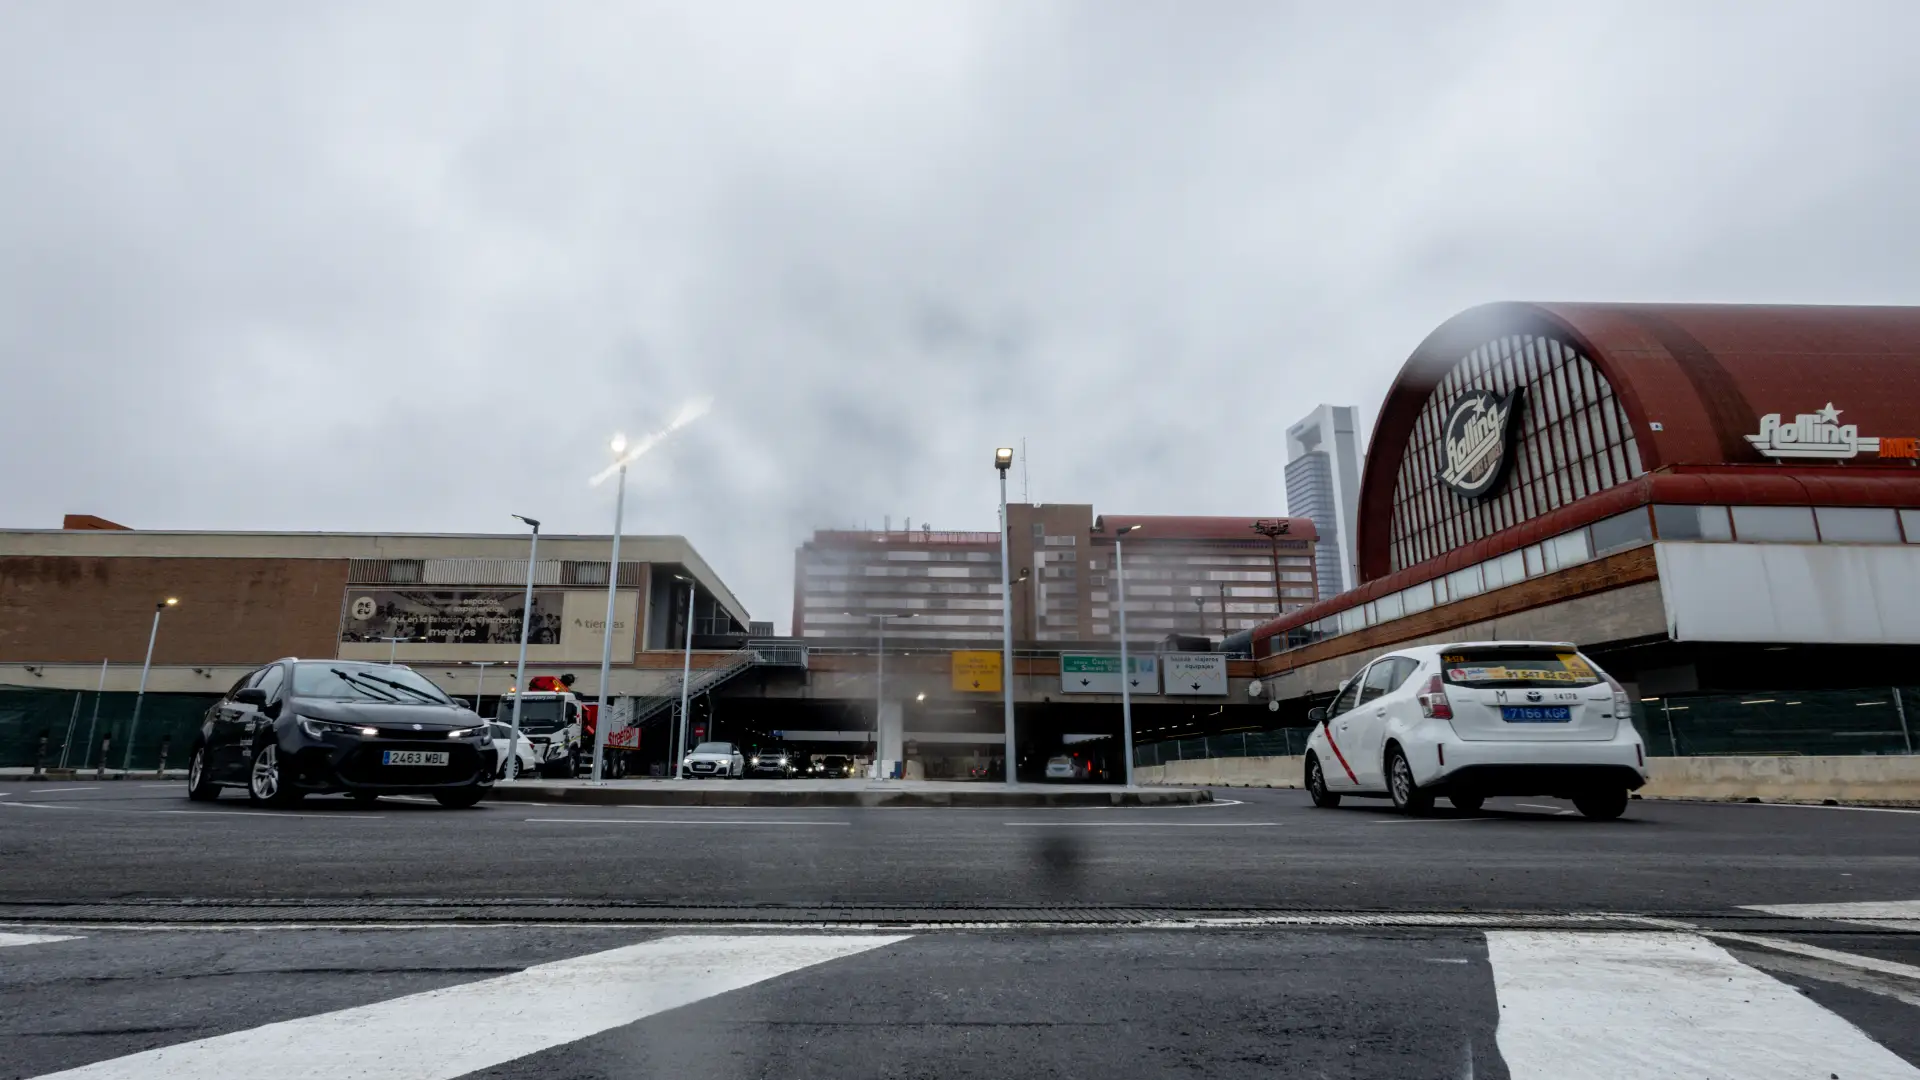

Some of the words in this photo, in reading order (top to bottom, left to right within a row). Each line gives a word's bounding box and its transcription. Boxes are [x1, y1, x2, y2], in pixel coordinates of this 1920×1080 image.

[1447, 403, 1501, 474] Rolling
[1757, 413, 1859, 457] Rolling
[585, 620, 625, 629] tienas
[1495, 690, 1509, 703] M
[1544, 707, 1568, 719] KGP
[391, 752, 421, 764] 2463
[425, 753, 445, 764] MBL
